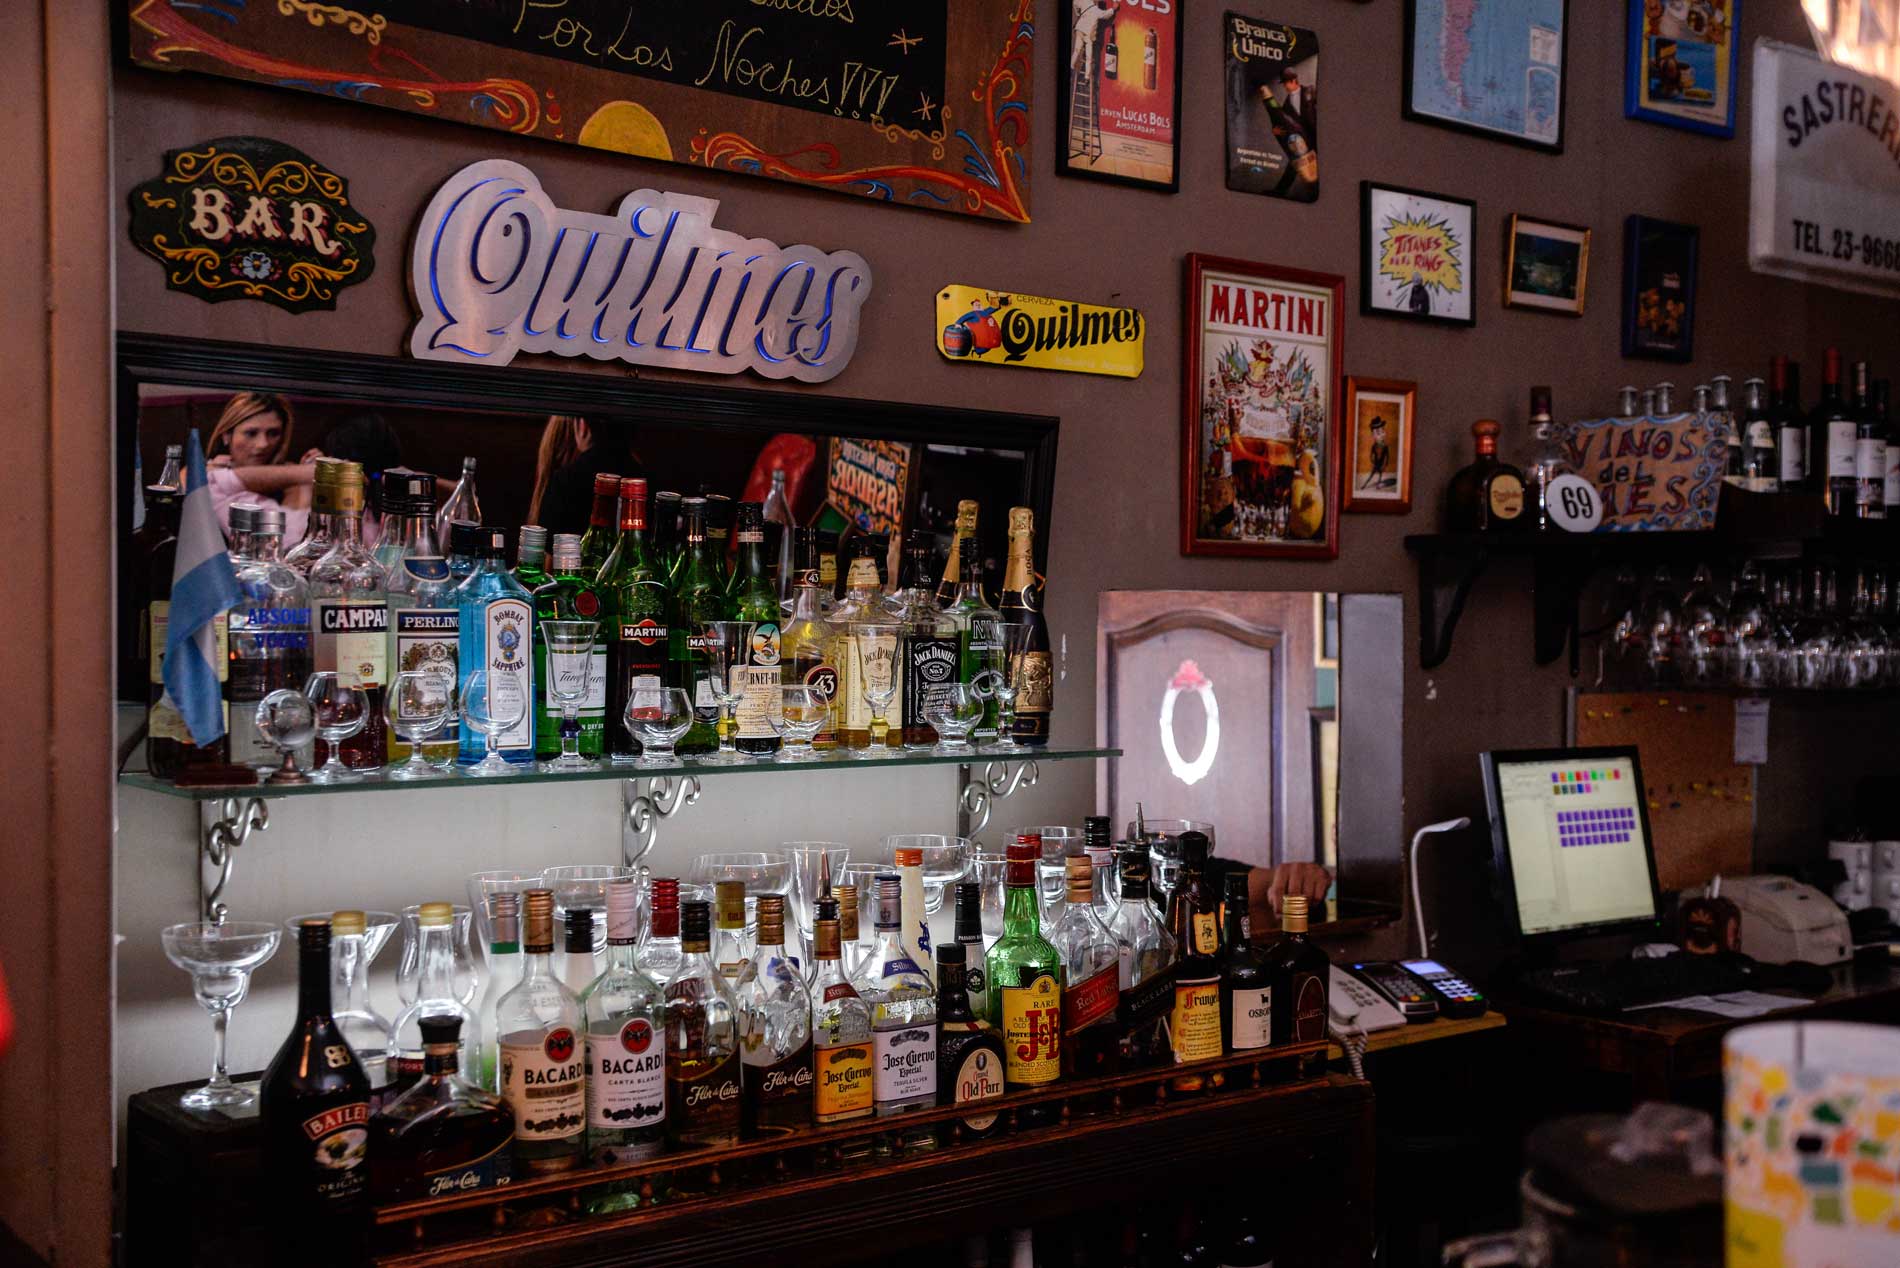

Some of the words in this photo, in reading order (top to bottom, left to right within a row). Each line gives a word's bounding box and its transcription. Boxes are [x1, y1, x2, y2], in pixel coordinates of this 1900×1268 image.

[1234, 18, 1287, 43] Branca
[1116, 120, 1156, 134] AMSTERDAM
[1122, 107, 1148, 124] LUCAS
[1149, 112, 1171, 129] BOLS
[189, 187, 343, 257] BAR
[1393, 234, 1443, 256] TITANES
[429, 177, 862, 366] Quilmes
[1414, 255, 1445, 272] RING
[1016, 295, 1055, 306] CERVEZA
[1208, 284, 1325, 337] MARTINI
[1000, 304, 1141, 362] Quilmes
[1565, 425, 1698, 469] VINOS
[1561, 486, 1594, 519] 69
[808, 572, 819, 583] 43
[493, 610, 524, 625] BOMBAY
[624, 627, 667, 637] MARTINI
[690, 638, 725, 647] MARTIN
[492, 656, 526, 672] SAPPHIRE
[914, 648, 931, 666] JACK
[811, 673, 835, 695] 43
[1033, 999, 1056, 1009] RARE
[1075, 991, 1096, 1011] Red
[1248, 1007, 1271, 1019] OSBO
[883, 1053, 904, 1071] Jose
[906, 1050, 935, 1067] Cuervo
[525, 1062, 583, 1084] BACARD
[763, 1072, 788, 1092] Flor
[824, 1070, 844, 1086] Jose
[844, 1066, 872, 1082] Cuervo
[686, 1085, 712, 1105] Flor
[719, 1080, 740, 1099] Caña
[962, 1080, 979, 1100] Old
[980, 1078, 1001, 1101] Parr
